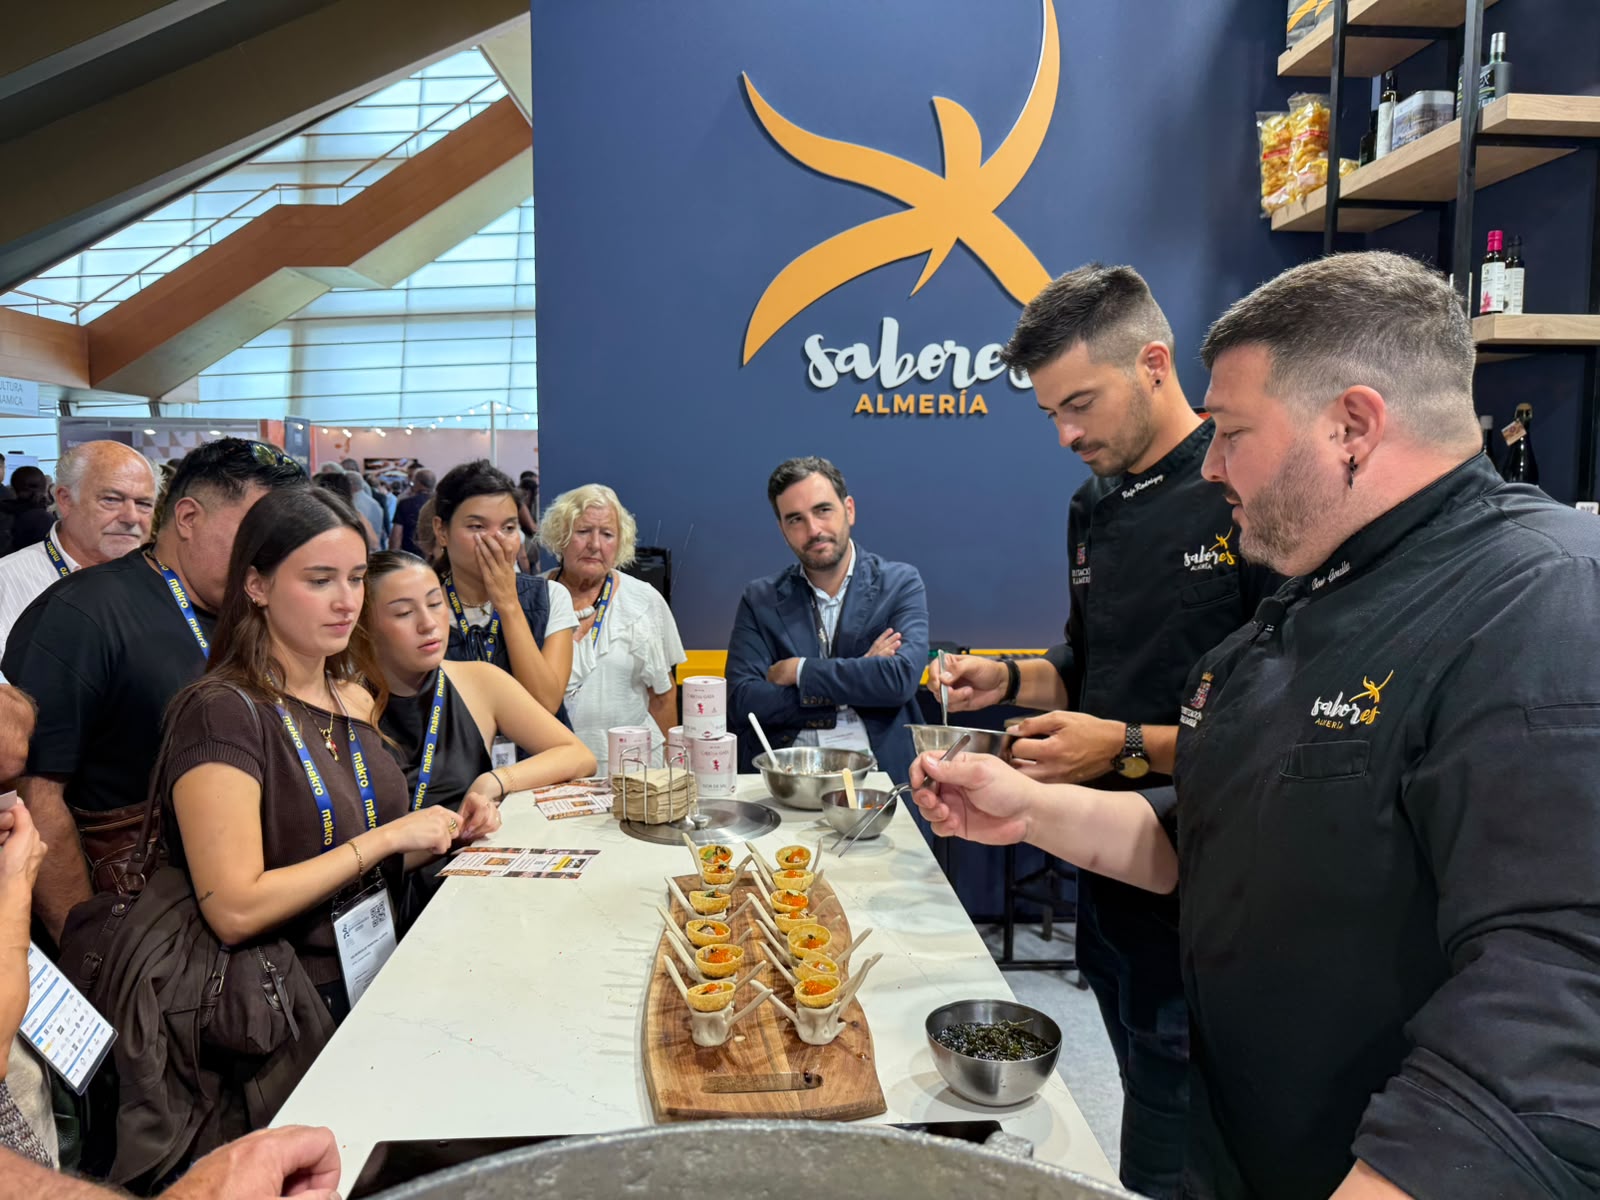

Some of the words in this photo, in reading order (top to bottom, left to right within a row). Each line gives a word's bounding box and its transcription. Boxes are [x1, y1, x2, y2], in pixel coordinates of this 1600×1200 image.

[854, 389, 989, 415] ALMERÍA
[169, 578, 189, 609] makro
[188, 617, 208, 648] makro
[437, 670, 445, 697] makro
[430, 705, 441, 735] makro
[1310, 690, 1380, 726] sabores
[283, 715, 303, 750] makro
[353, 751, 369, 788] makro
[423, 743, 434, 773] makro
[304, 759, 324, 796] makro
[321, 808, 333, 846] makro
[364, 798, 377, 829] makr
